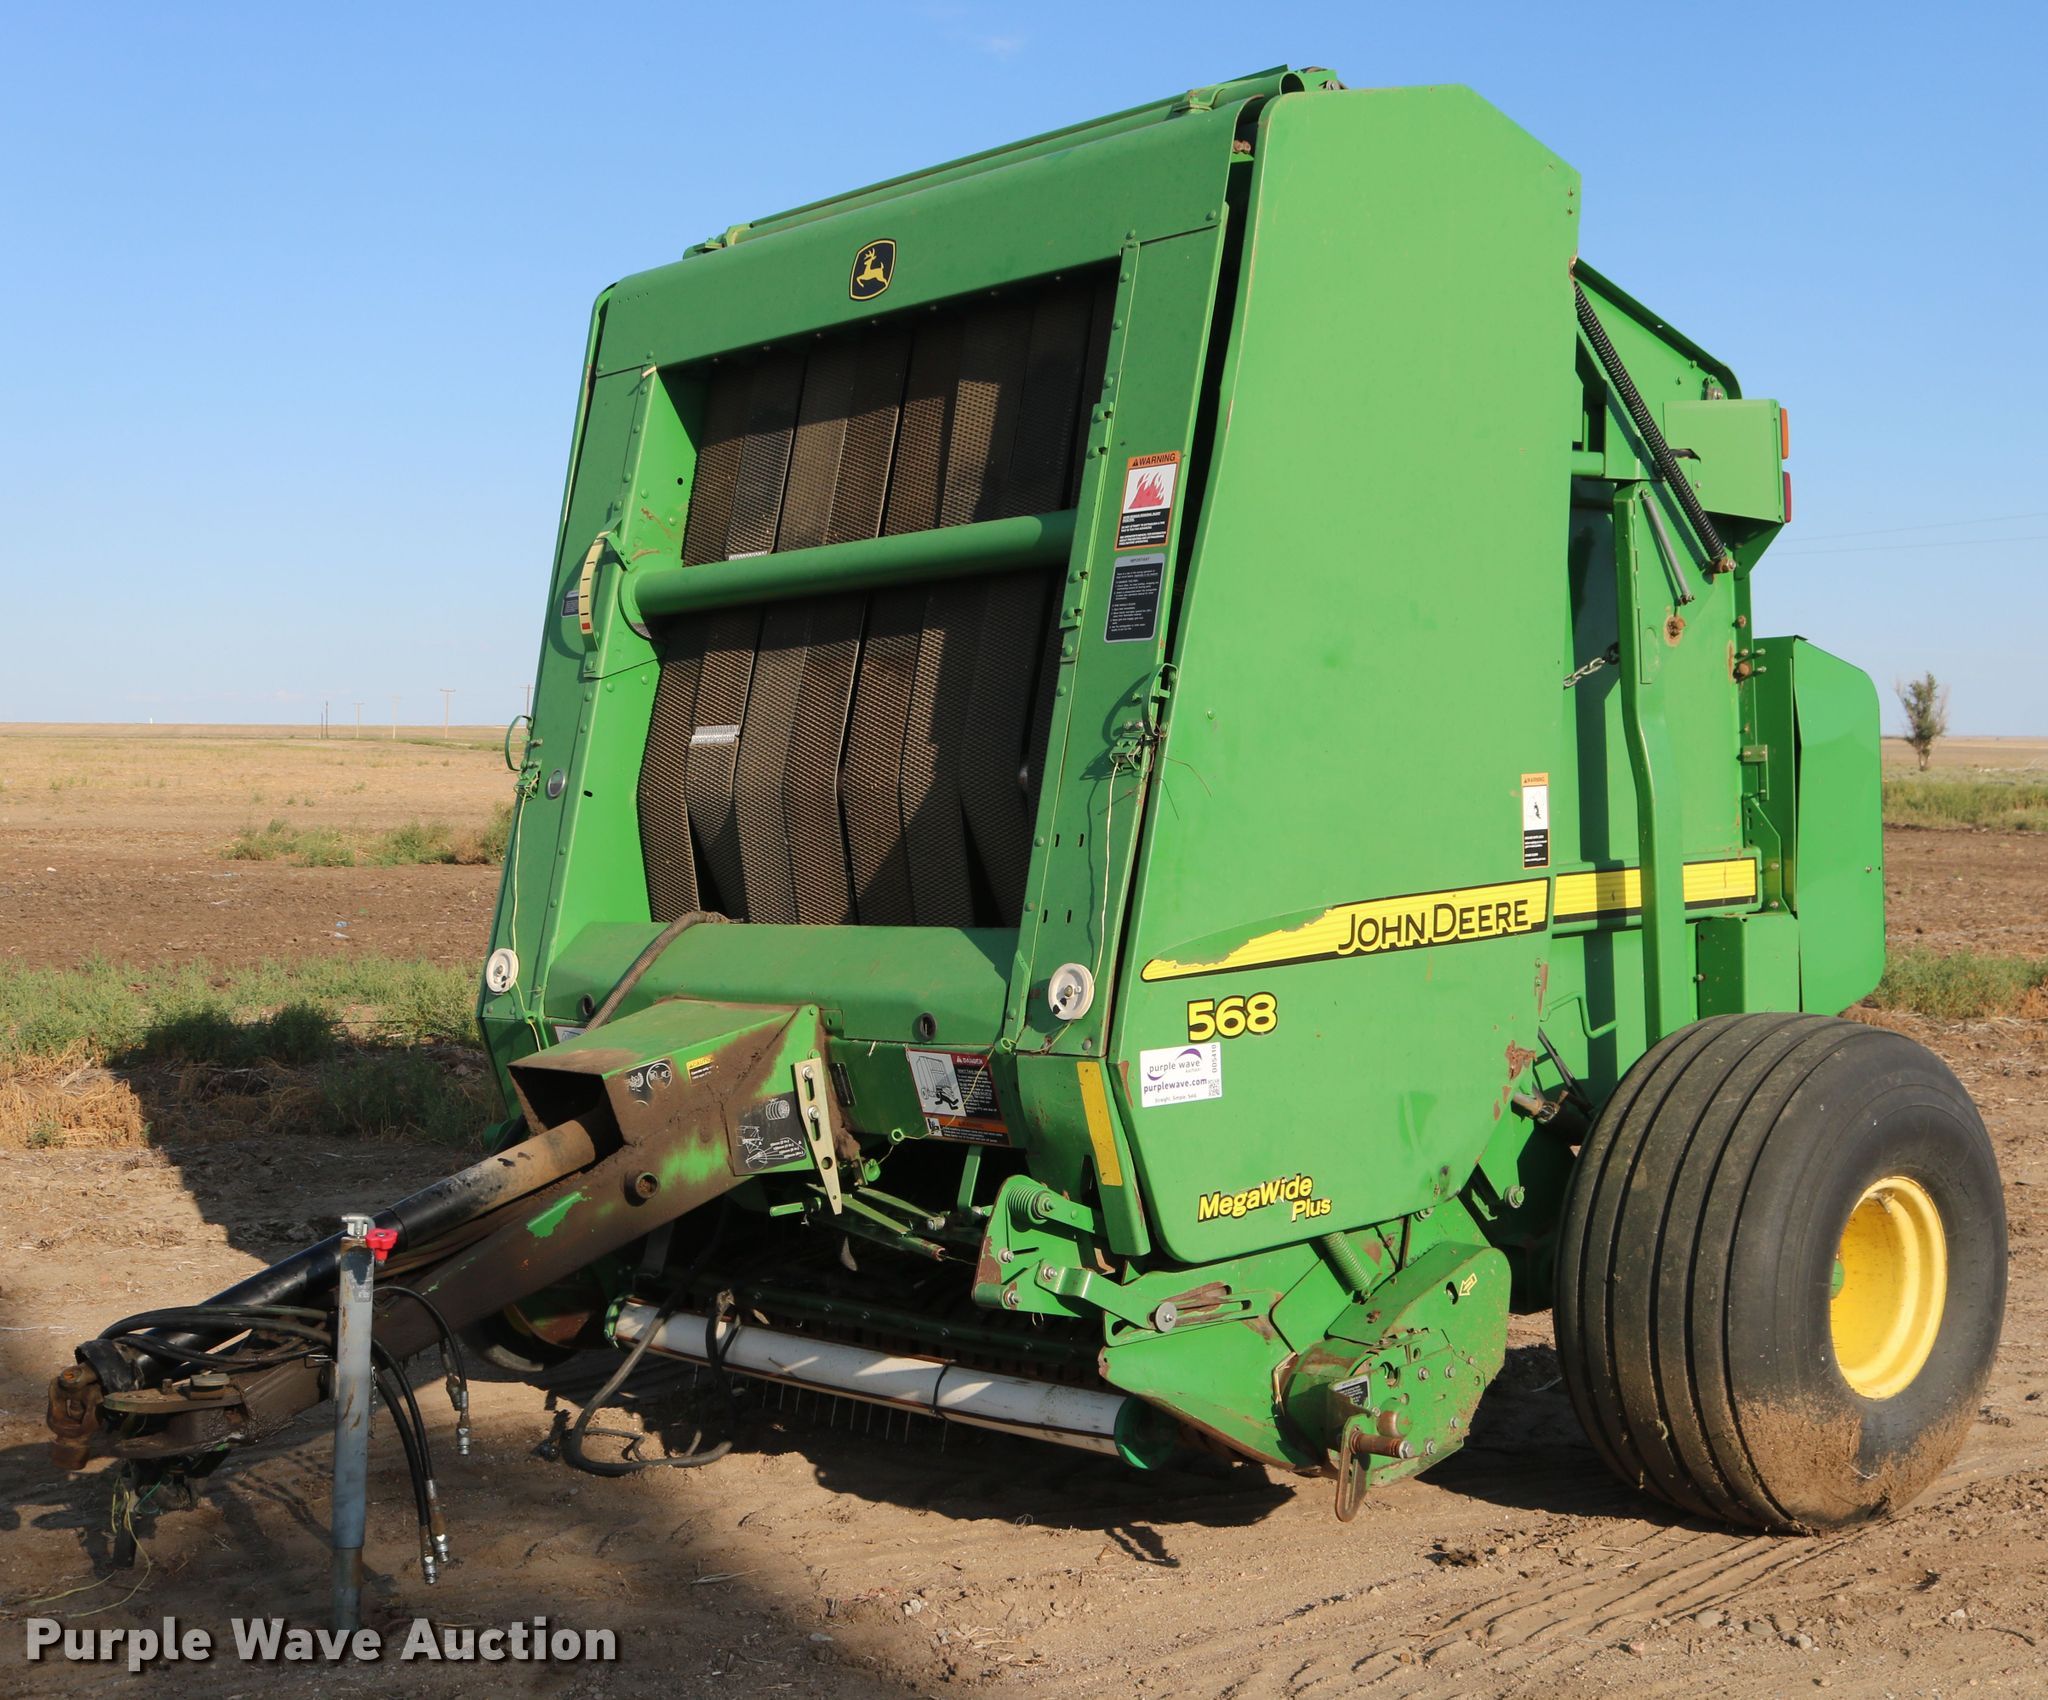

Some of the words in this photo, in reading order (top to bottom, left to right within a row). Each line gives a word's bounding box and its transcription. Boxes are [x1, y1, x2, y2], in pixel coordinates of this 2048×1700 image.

[1139, 453, 1176, 466] WARNING
[1338, 912, 1426, 951] JOHN
[1432, 899, 1529, 939] DEERE
[1187, 991, 1278, 1043] 568
[1149, 1061, 1176, 1074] purple
[1178, 1060, 1201, 1069] wave
[1144, 1079, 1207, 1094] purplewave.com
[1198, 1173, 1314, 1223] MegaWide
[1291, 1198, 1332, 1222] Plus
